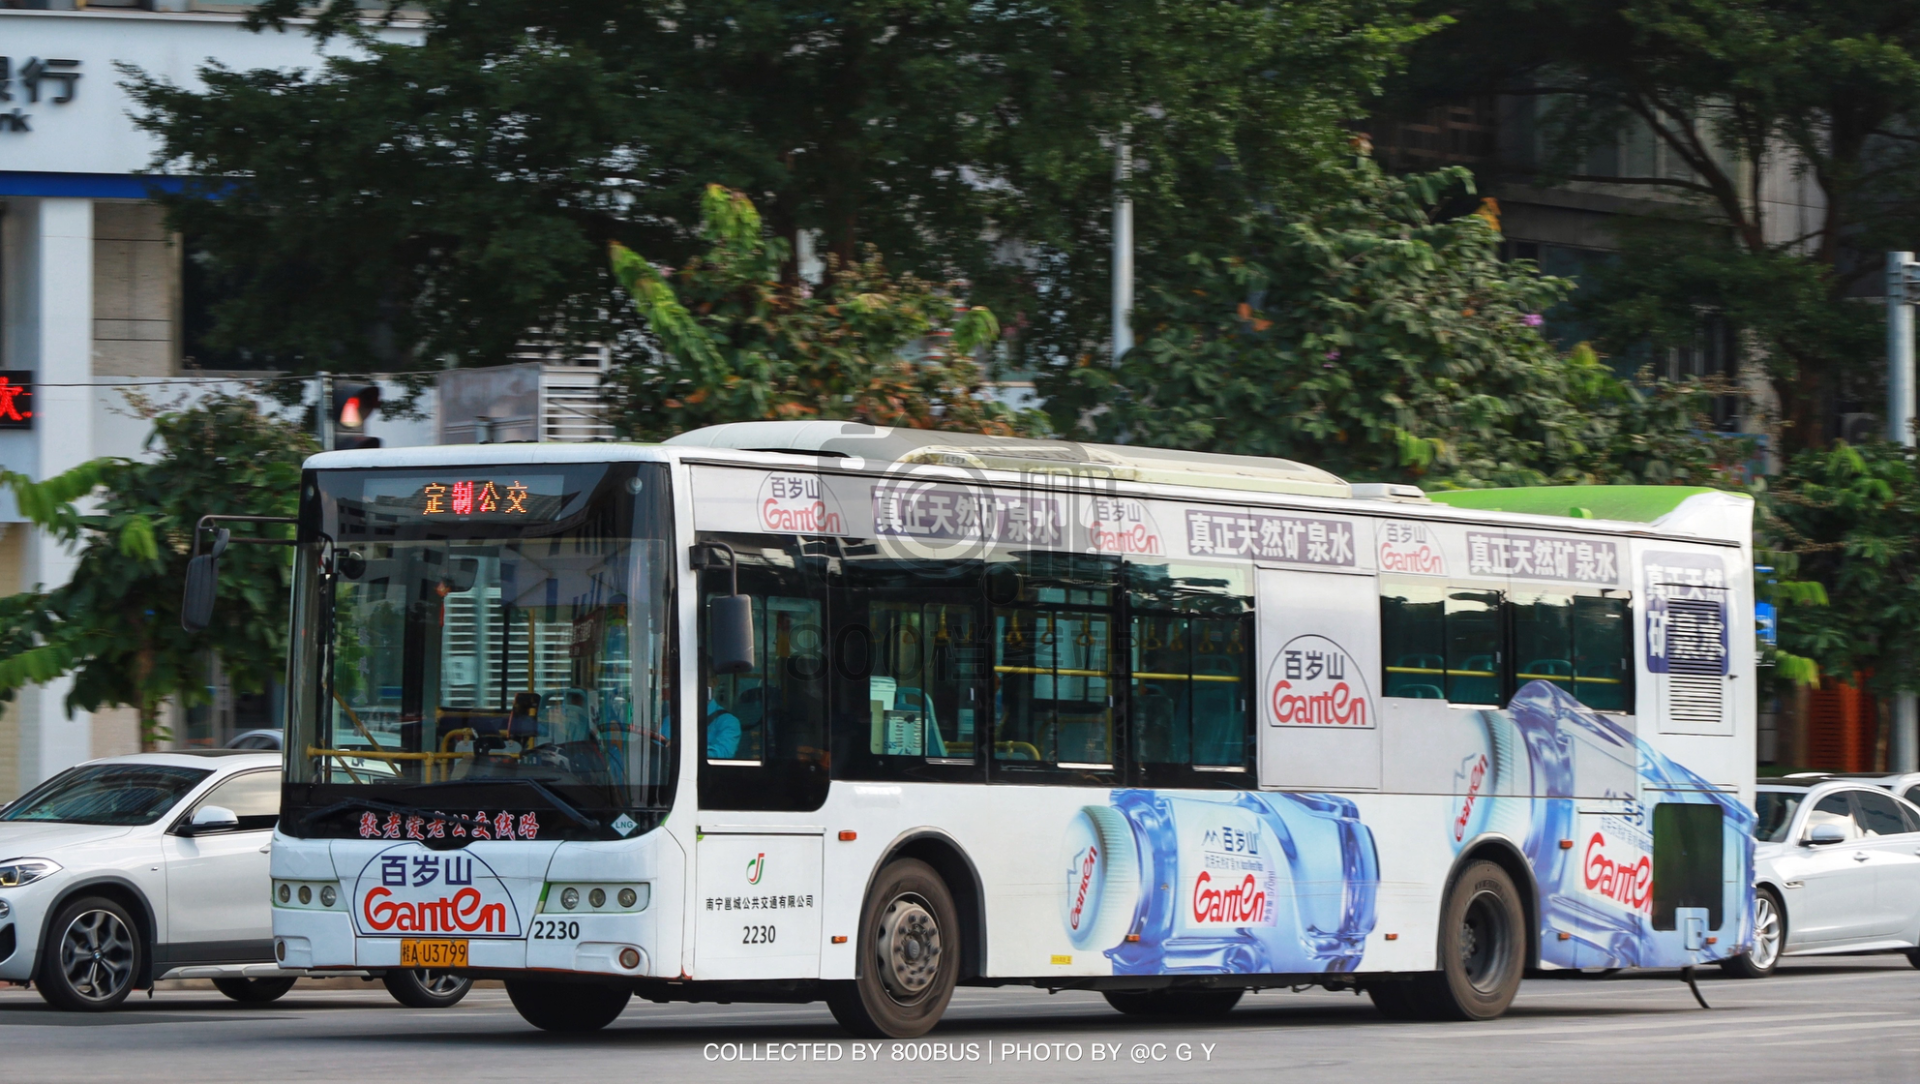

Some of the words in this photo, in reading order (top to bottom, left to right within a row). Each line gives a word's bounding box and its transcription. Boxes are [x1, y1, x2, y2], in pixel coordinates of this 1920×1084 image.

[423, 480, 527, 514] 定制公交
[771, 477, 820, 500] 百岁山
[875, 490, 1061, 545] 真正天然矿泉水
[1098, 501, 1141, 523] 百岁山
[1189, 513, 1352, 563] 真正天然矿泉水
[1387, 523, 1426, 544] 百岁山
[1469, 534, 1617, 582] 真正天然矿泉水
[1645, 563, 1725, 602] 真正天然
[1285, 650, 1345, 680] 百岁山
[359, 810, 540, 841] 敬老爱老公交线路
[615, 819, 634, 829] LNG
[1222, 826, 1259, 855] 百岁山
[380, 854, 472, 888] 百岁山
[705, 894, 814, 911] 南宁邕城公共交通有限公司
[533, 920, 580, 940] 2230
[742, 925, 776, 944] 2230
